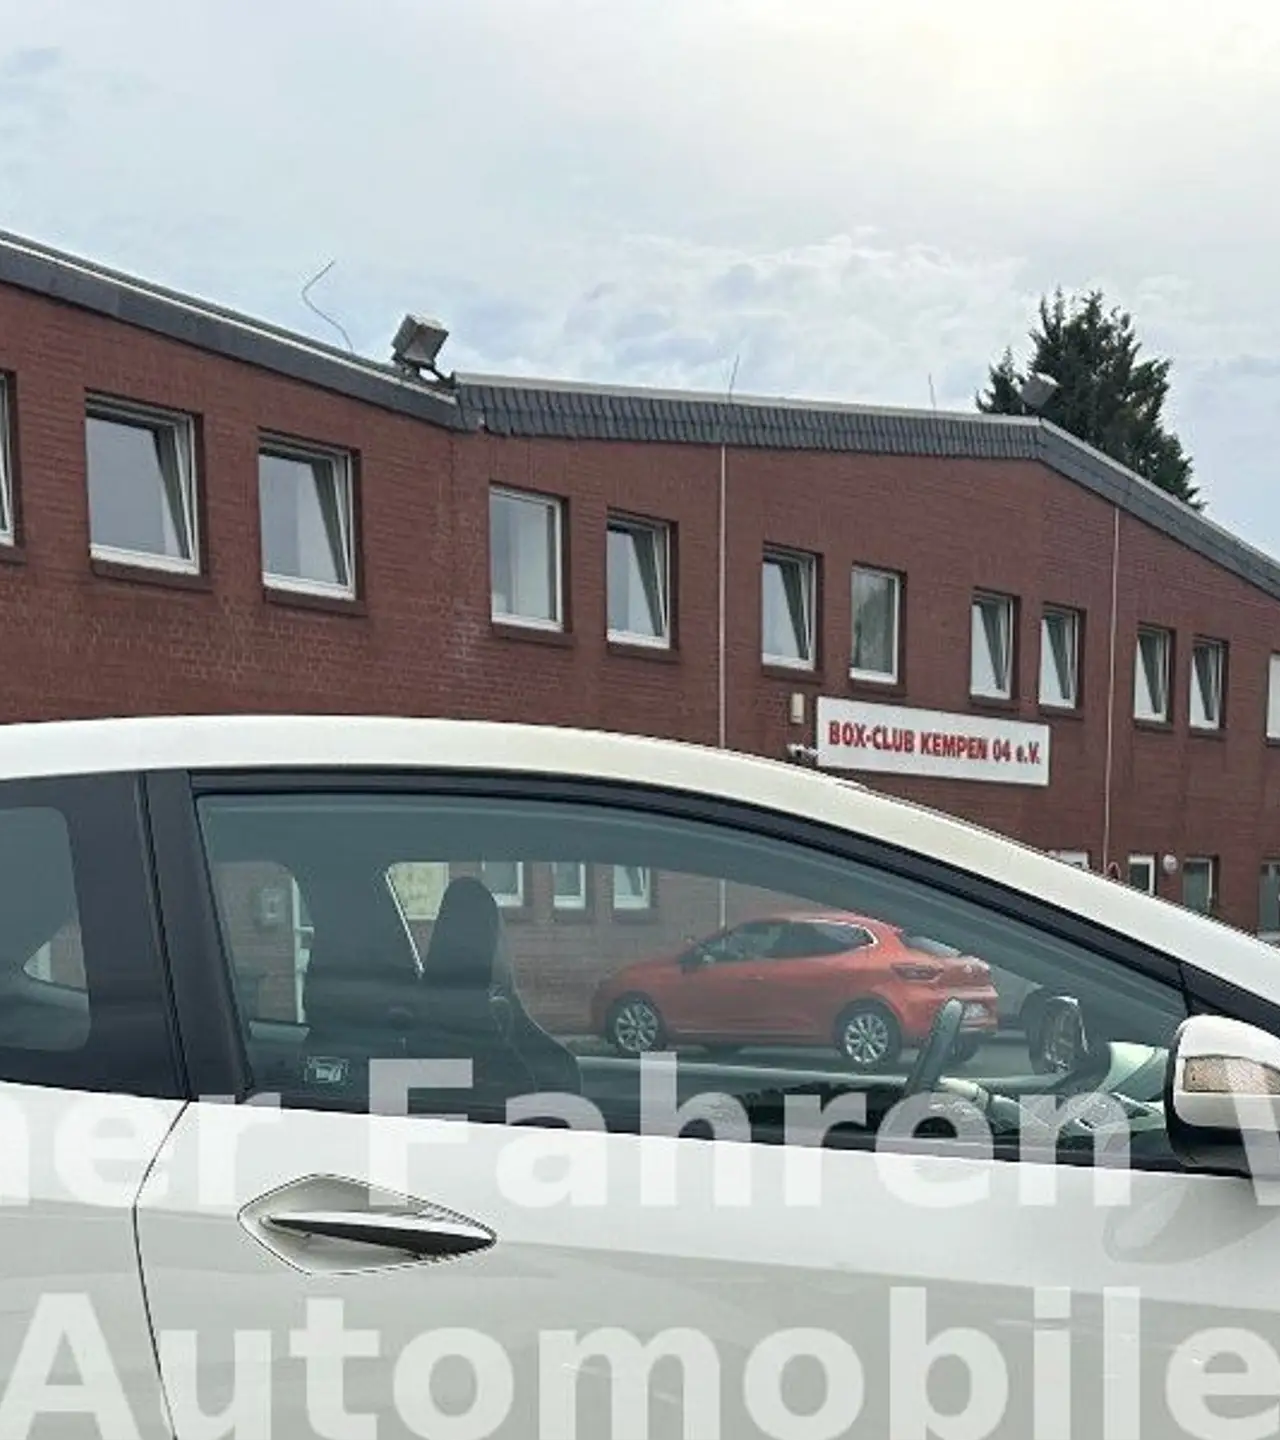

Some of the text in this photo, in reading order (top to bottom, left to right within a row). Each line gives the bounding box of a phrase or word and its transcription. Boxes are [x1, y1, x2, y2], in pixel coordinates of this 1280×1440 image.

[828, 720, 1041, 765] BOX-CLUB KEMPEN 04 e.V.
